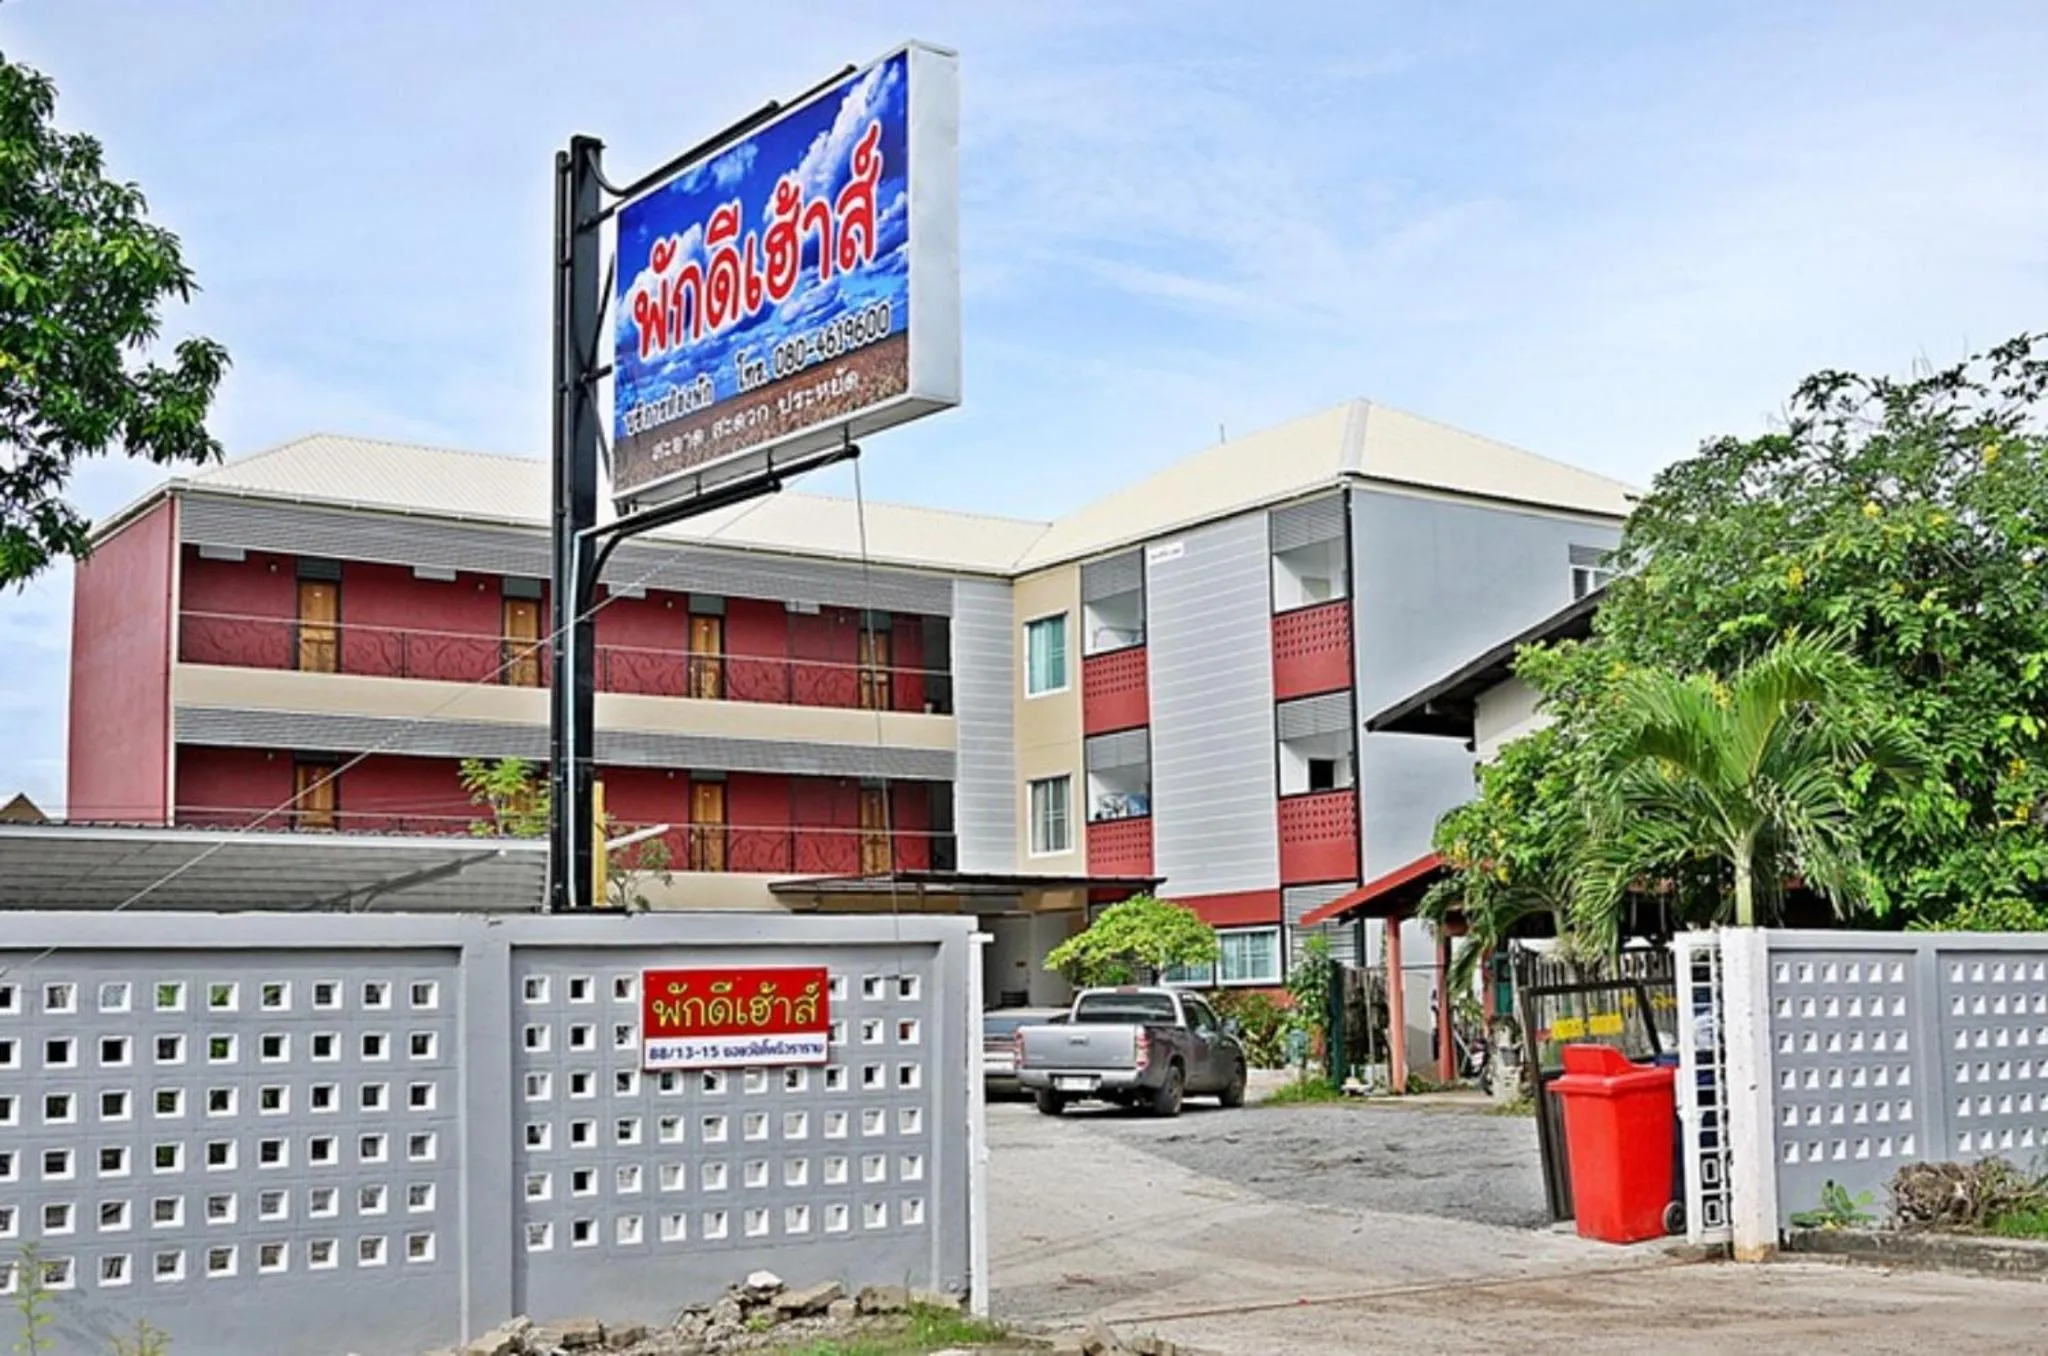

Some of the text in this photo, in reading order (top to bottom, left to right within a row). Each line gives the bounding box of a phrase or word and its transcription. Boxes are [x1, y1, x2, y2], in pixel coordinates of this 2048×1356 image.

[633, 122, 882, 360] พักดีเฮ้าส์
[774, 302, 892, 380] 080-4619600
[712, 404, 769, 440] สะดวก
[778, 366, 859, 415] ประหยัด
[652, 982, 820, 1027] พักดีเฮ้าส์
